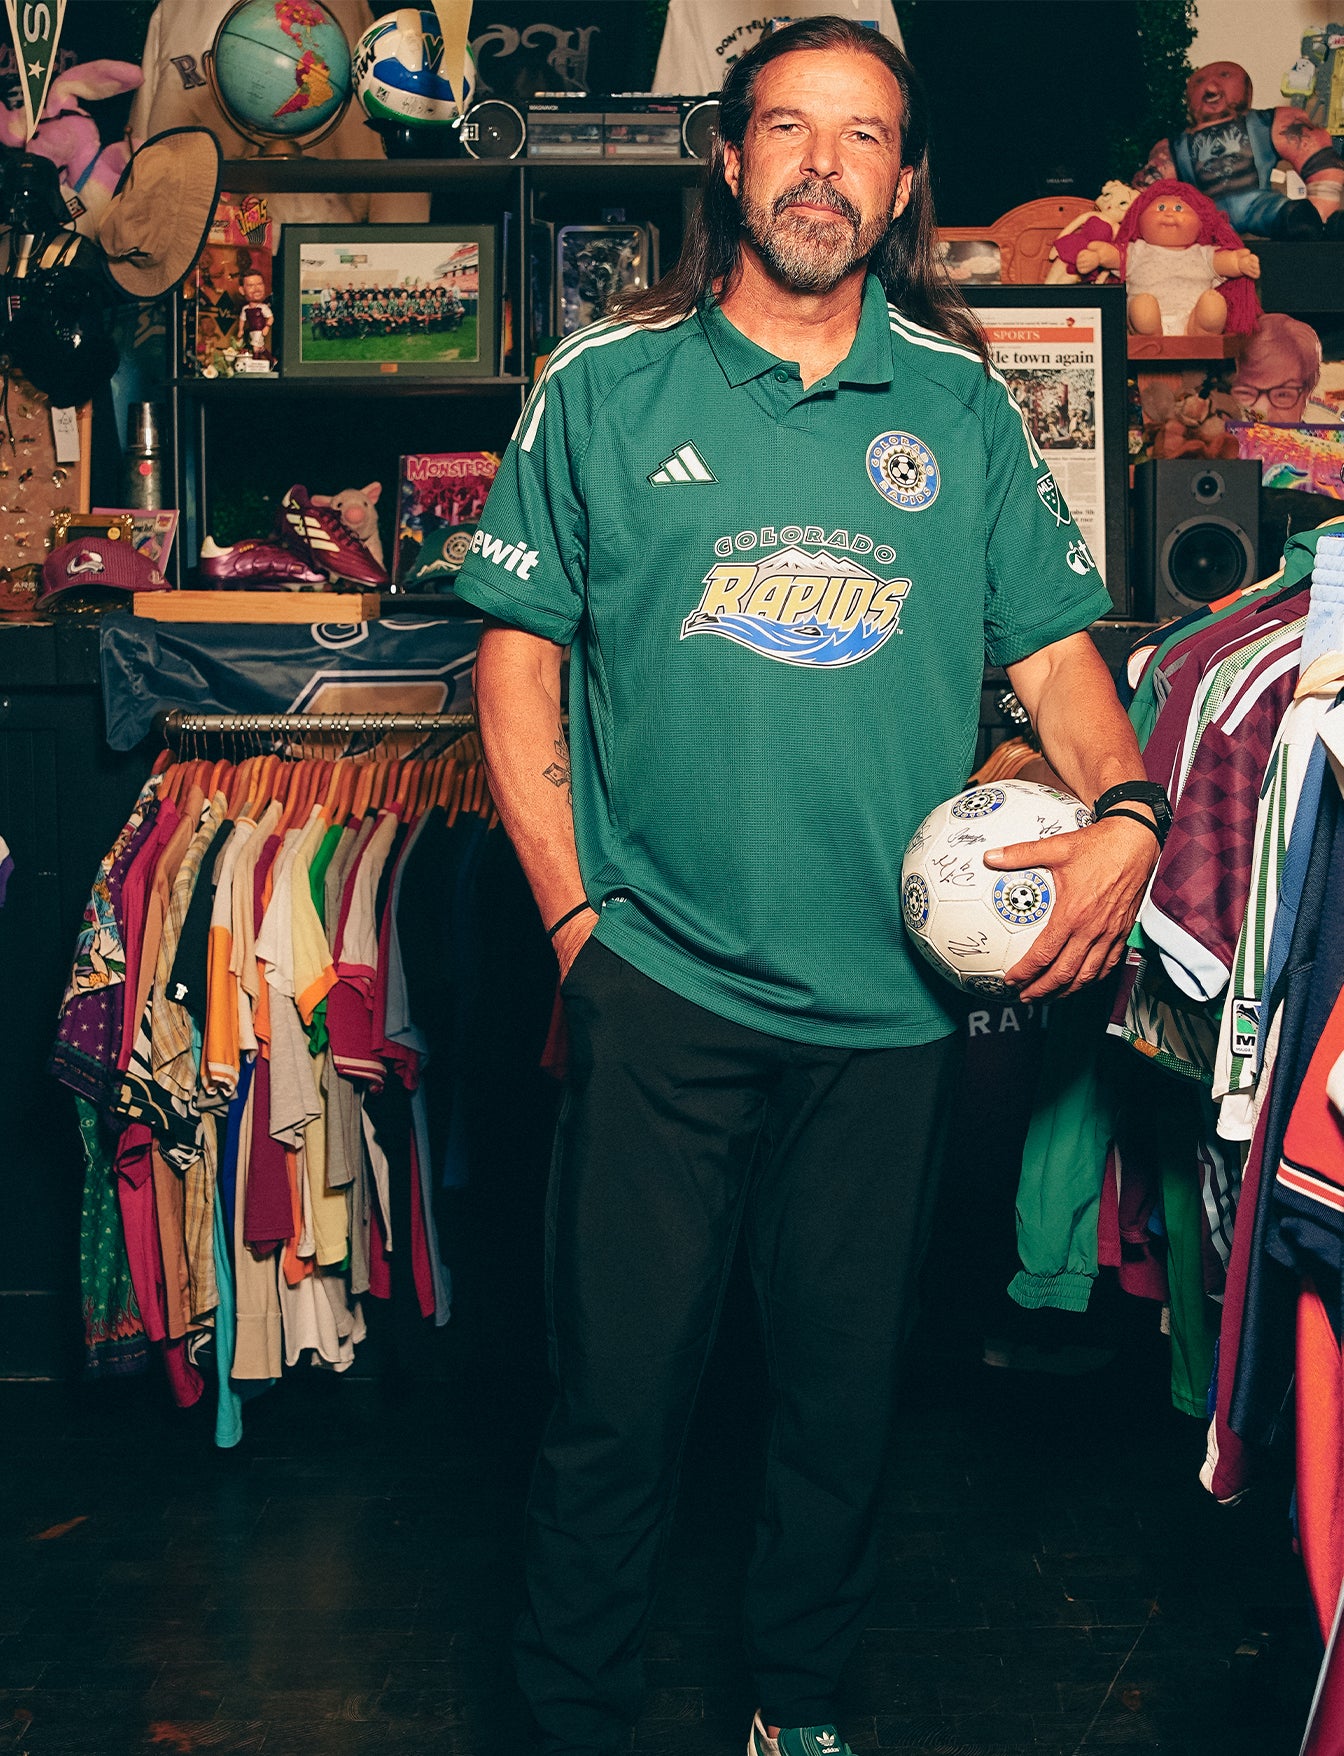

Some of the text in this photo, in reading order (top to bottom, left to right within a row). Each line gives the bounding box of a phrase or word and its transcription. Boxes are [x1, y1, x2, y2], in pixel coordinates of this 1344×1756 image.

[716, 26, 744, 56] DON'T
[992, 330, 1041, 341] SPORTS
[1014, 353, 1051, 364] town
[1055, 350, 1095, 366] again
[1037, 478, 1054, 496] MLS
[714, 525, 897, 564] COLORADO
[702, 564, 912, 633] RAPIDS
